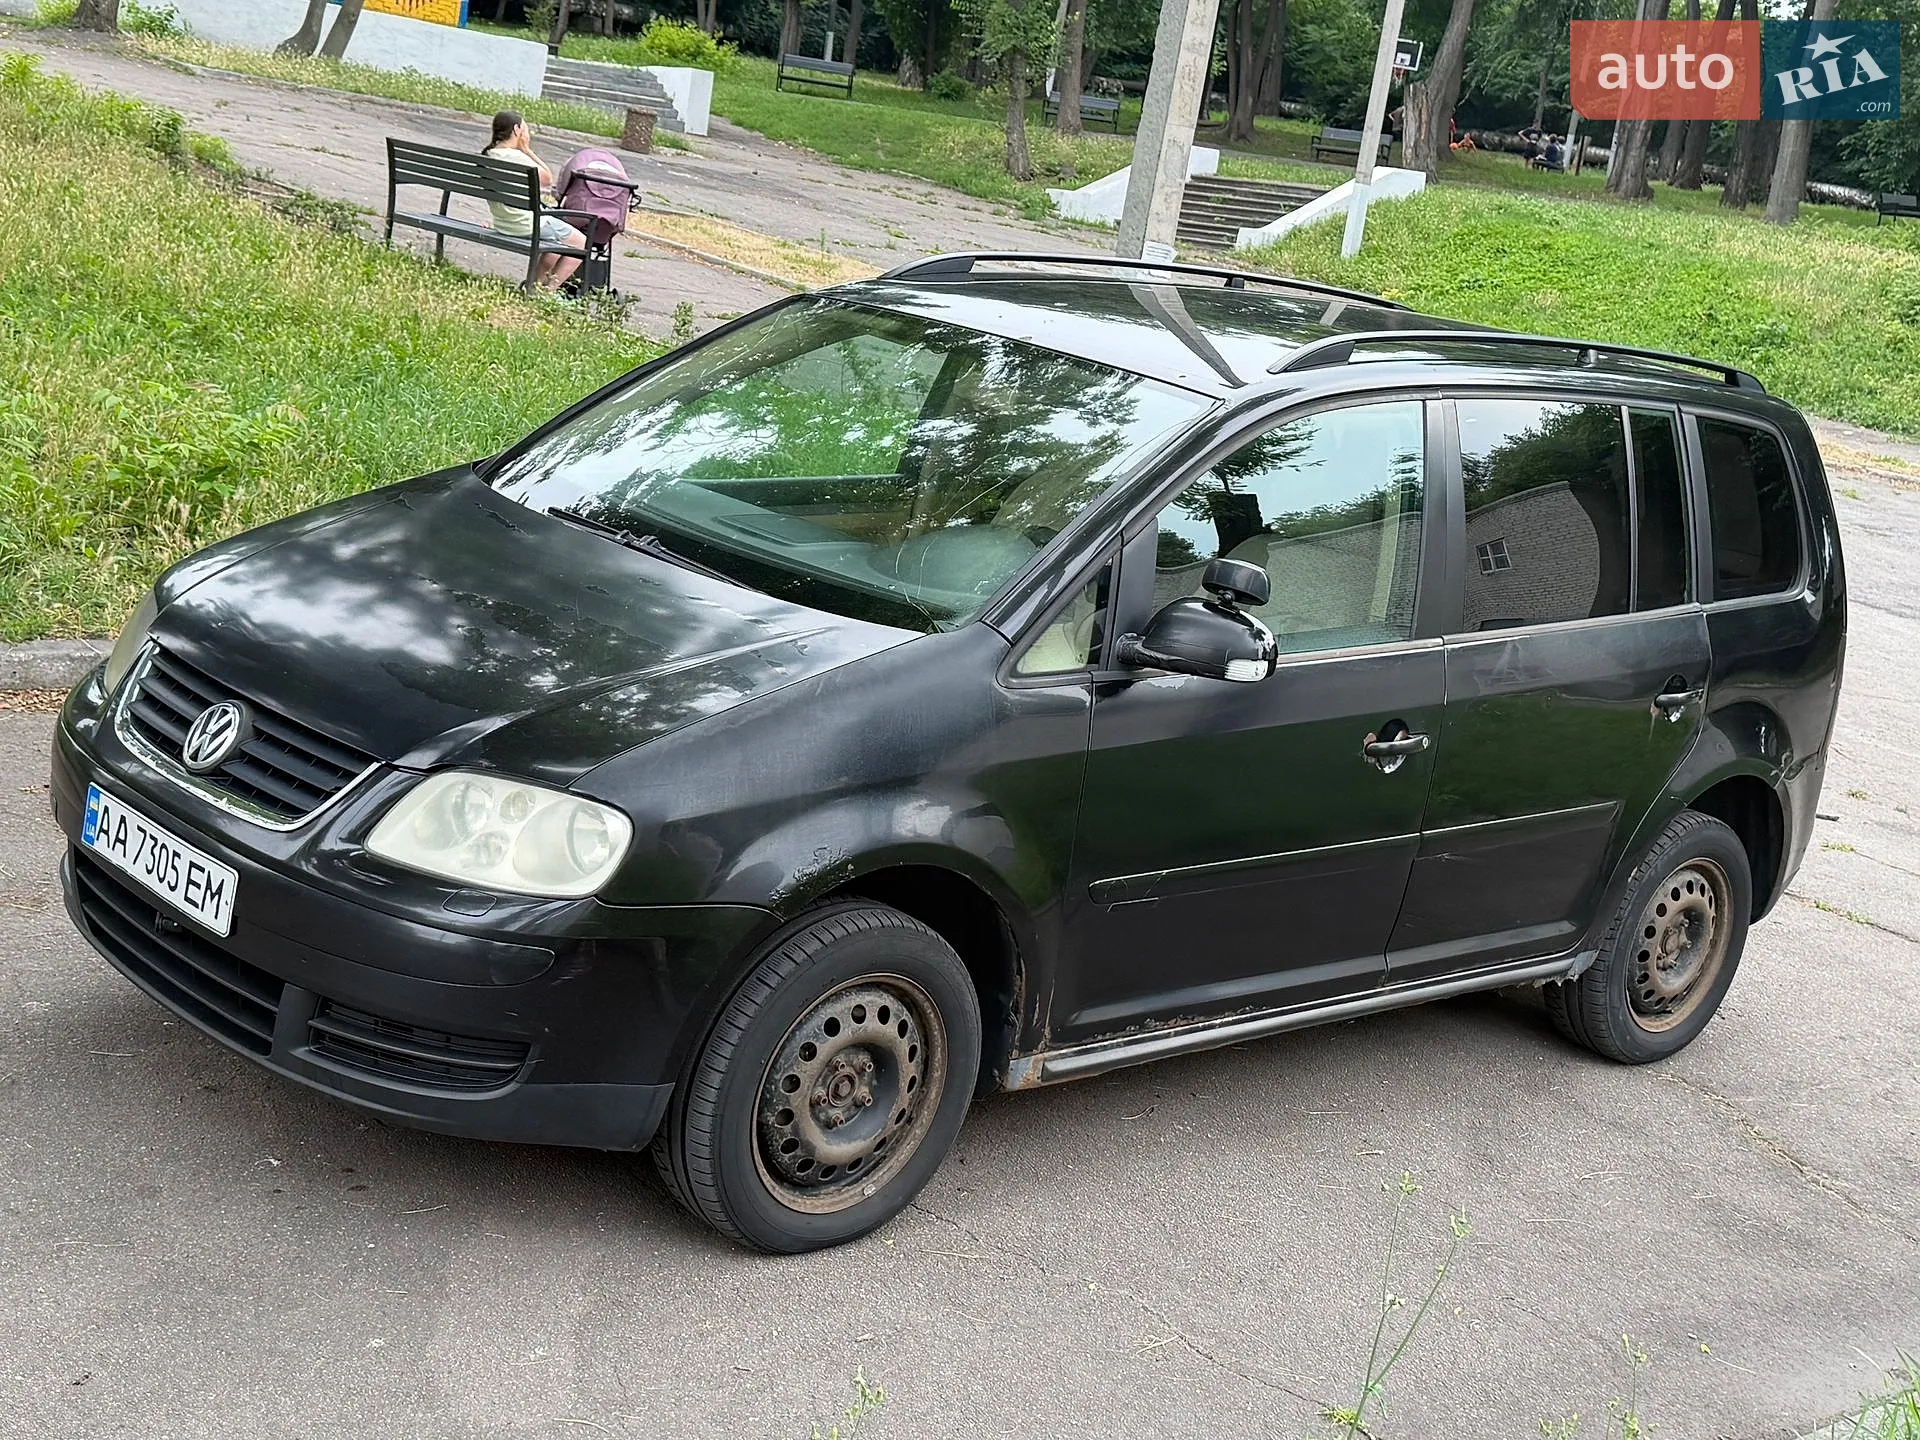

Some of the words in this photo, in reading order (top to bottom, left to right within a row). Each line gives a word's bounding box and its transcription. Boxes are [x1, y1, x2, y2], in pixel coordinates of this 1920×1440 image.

[96, 804, 129, 858] AA
[132, 824, 182, 893] 7305
[184, 860, 225, 920] EM
